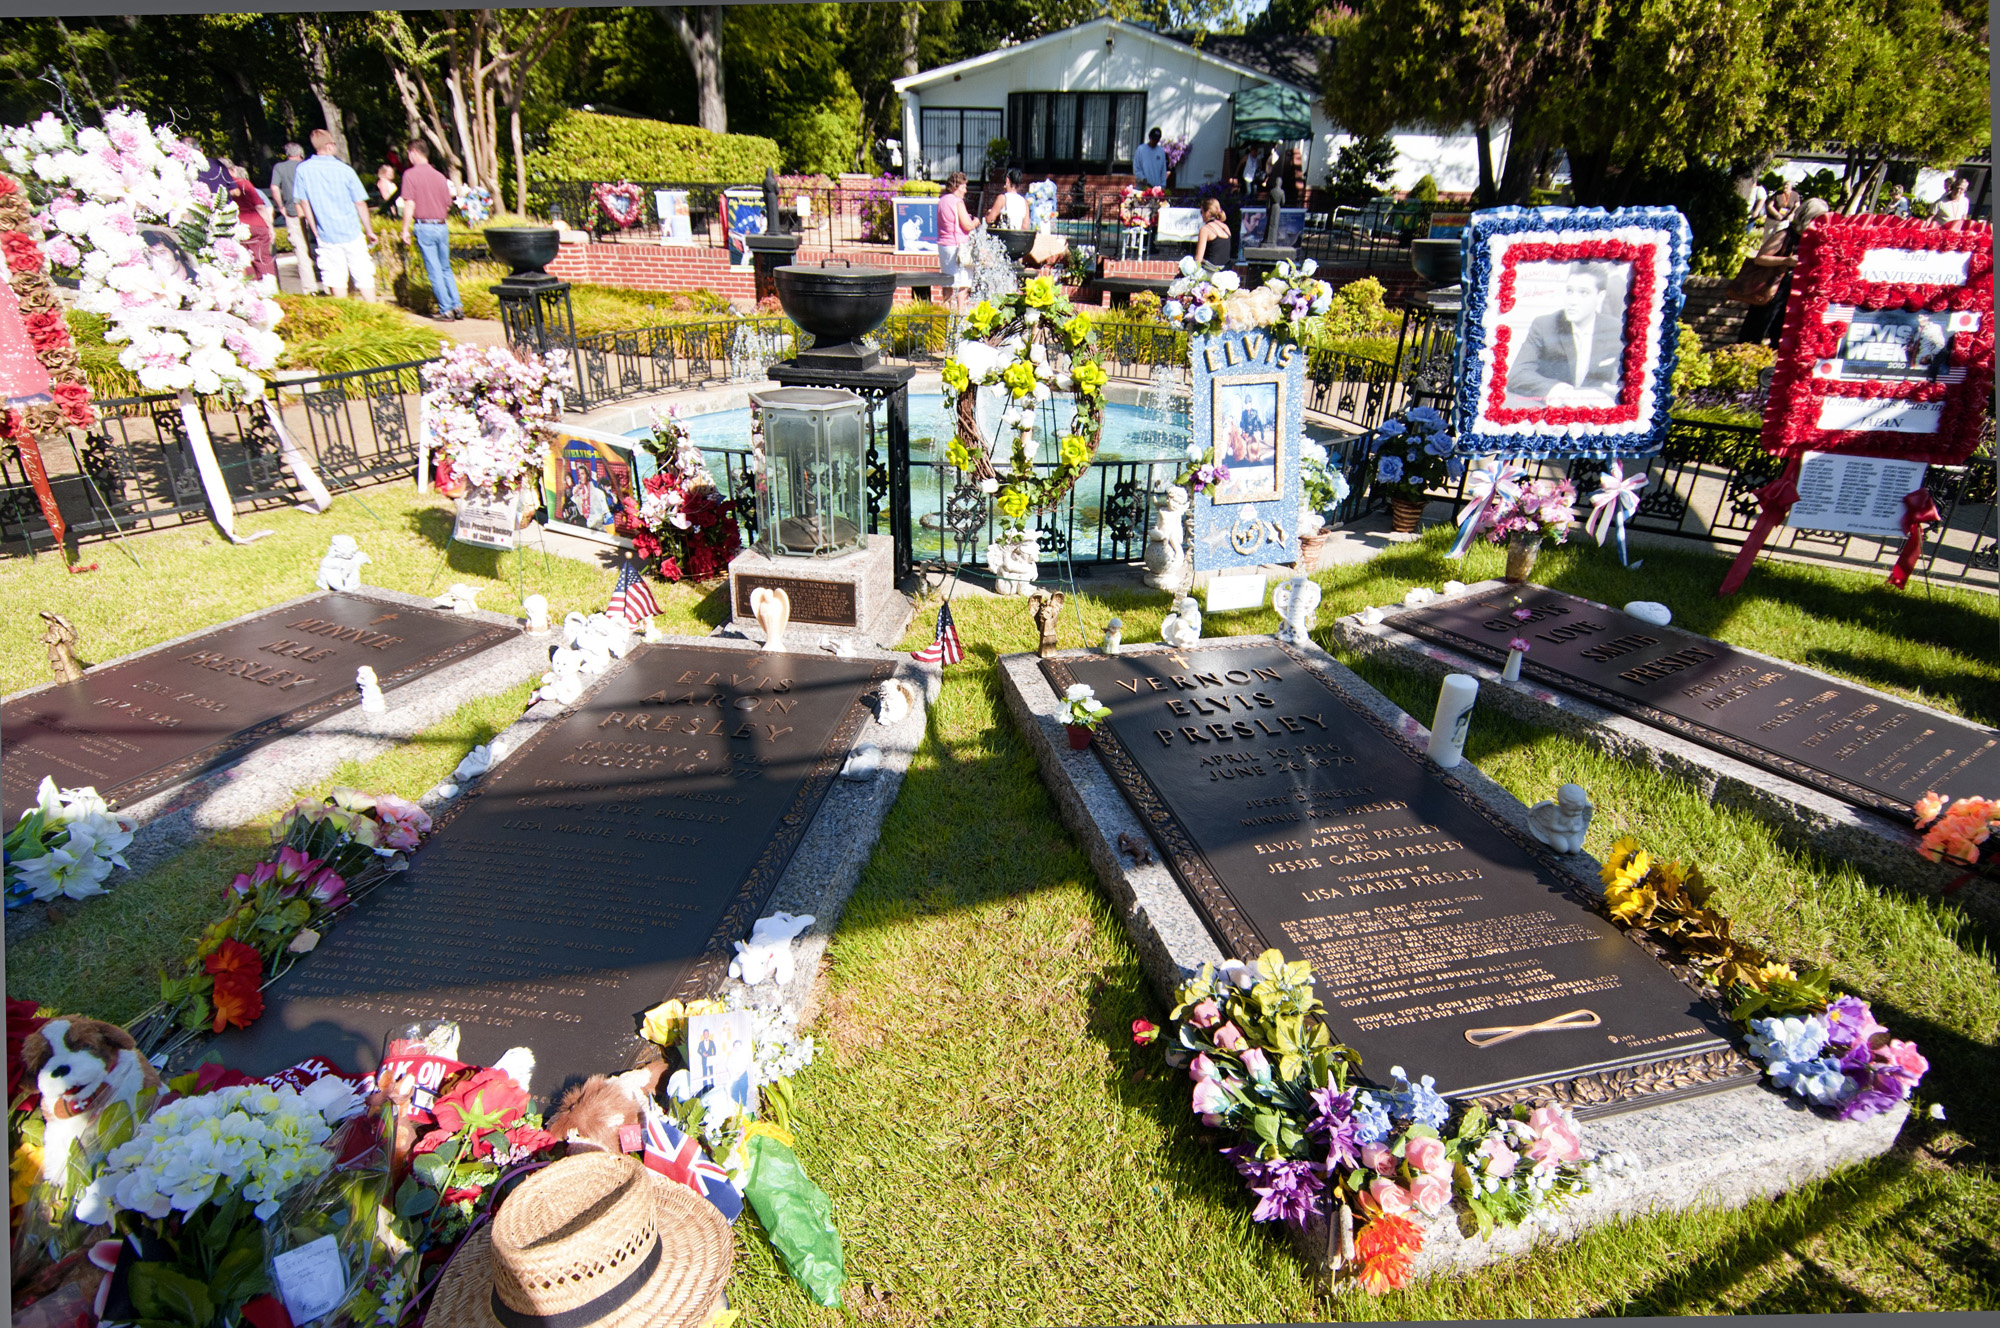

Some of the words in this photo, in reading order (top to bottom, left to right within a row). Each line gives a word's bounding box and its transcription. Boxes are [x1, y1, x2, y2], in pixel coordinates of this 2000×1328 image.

[1861, 270, 1962, 285] ANNIVERSARY
[1848, 322, 1913, 343] ELVIS
[1203, 334, 1298, 374] ELVIS
[1847, 341, 1908, 362] WEEK
[1887, 362, 1907, 370] 2010
[1868, 399, 1897, 408] Elvis
[1901, 399, 1929, 410] Fans
[1930, 403, 1943, 411] in
[1859, 416, 1905, 428] JAPAN
[285, 618, 404, 650] MINNIE
[1535, 619, 1606, 644] LOVE
[258, 639, 336, 663] MAE
[1580, 633, 1661, 663] SMITH
[177, 650, 317, 690] PRESLEY
[1618, 646, 1717, 685] PRESLEY
[675, 670, 793, 694] ELVIS
[1114, 666, 1284, 694] VERNON
[640, 689, 798, 715] AARON
[1166, 692, 1276, 717] ELVIS
[598, 711, 793, 743] PRESLEY
[1153, 713, 1329, 747] PRESLEY
[575, 740, 688, 757] JANUARY
[1200, 751, 1260, 768] APRIL
[560, 754, 664, 769] AUGUST
[711, 766, 764, 780] 1977
[1209, 765, 1267, 782] JUNE
[534, 779, 608, 791] VERNON
[616, 786, 666, 796] ELVIS
[673, 790, 745, 806] PRESLEY
[1246, 796, 1291, 810] JESSE
[1310, 785, 1376, 801] PRESLEY
[516, 797, 587, 811] GLADYS
[594, 804, 646, 816] LOVE
[654, 808, 731, 824] PRESLEY
[1240, 812, 1301, 827] MINNIE
[1305, 808, 1341, 821] MAE
[1343, 800, 1410, 816] PRESLEY
[502, 819, 544, 831] LISA
[552, 823, 614, 837] MARIE
[624, 830, 703, 846] PRESLEY
[1254, 839, 1304, 856] ELVIS
[1311, 832, 1370, 849] AARON
[1372, 823, 1441, 841] PRESLEY
[1314, 825, 1352, 836] FATHER
[1353, 822, 1367, 831] OF
[1268, 857, 1323, 875] JESSIE
[1394, 840, 1465, 859] PRESLEY
[1347, 842, 1371, 853] AND
[1301, 887, 1345, 903] LISA
[1348, 878, 1408, 897] MARIE
[1410, 867, 1484, 888] PRESLEY
[1338, 867, 1413, 884] GRANDFATHER
[1415, 864, 1431, 873] OF
[1332, 988, 1358, 998] LOVE
[1371, 979, 1411, 992] PATIENT
[1414, 975, 1434, 985] AND
[1435, 967, 1486, 981] ENDURETH
[1488, 964, 1505, 973] ALL
[1505, 958, 1544, 970] THINGS.
[1340, 997, 1369, 1008] GOD'S
[1371, 990, 1409, 1003] FINGER
[1409, 983, 1456, 996] TOUCHED
[1458, 979, 1479, 988] HIM
[1480, 975, 1501, 985] AND
[1502, 973, 1517, 981] HE
[1507, 973, 1557, 987] TENNYSON
[1353, 1012, 1396, 1025] THOUGH
[1398, 1005, 1434, 1017] YOU'RE
[1436, 999, 1465, 1010] GONE
[1466, 994, 1495, 1006] FROM
[1510, 990, 1526, 998] WE
[1526, 986, 1551, 995] WILL
[1551, 978, 1595, 992] FOREVER
[1594, 974, 1620, 983] HOLD
[1359, 1022, 1381, 1032] YOU
[1383, 1015, 1417, 1028] CLOSE
[1418, 1013, 1432, 1022] IN
[1432, 1009, 1456, 1019] OUR
[1456, 1001, 1494, 1015] HEARTS
[1495, 998, 1522, 1007] WITH
[1523, 989, 1571, 1003] PRECIOUS
[1572, 981, 1623, 995] MEMORIES.
[417, 1061, 447, 1091] ON
